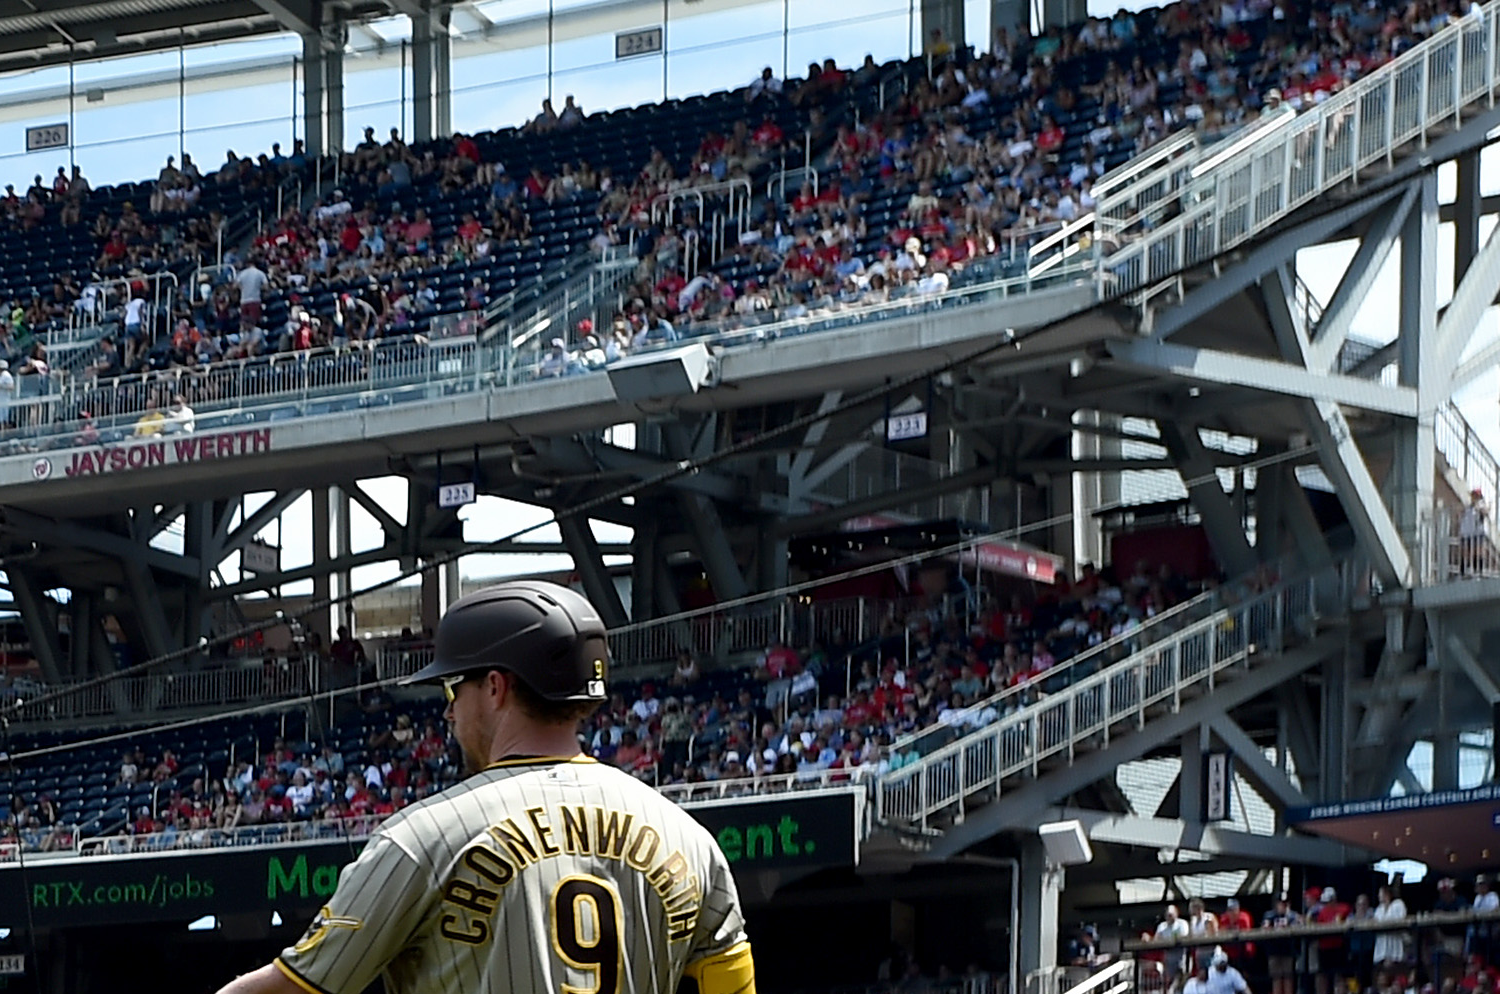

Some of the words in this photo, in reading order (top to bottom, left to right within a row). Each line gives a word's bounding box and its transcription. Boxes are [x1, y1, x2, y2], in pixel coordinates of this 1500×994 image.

[64, 442, 166, 477] JAYSON
[174, 428, 271, 462] WERTH
[33, 874, 215, 909] RTX.com/jobs
[440, 803, 703, 948] CRONENWORTH
